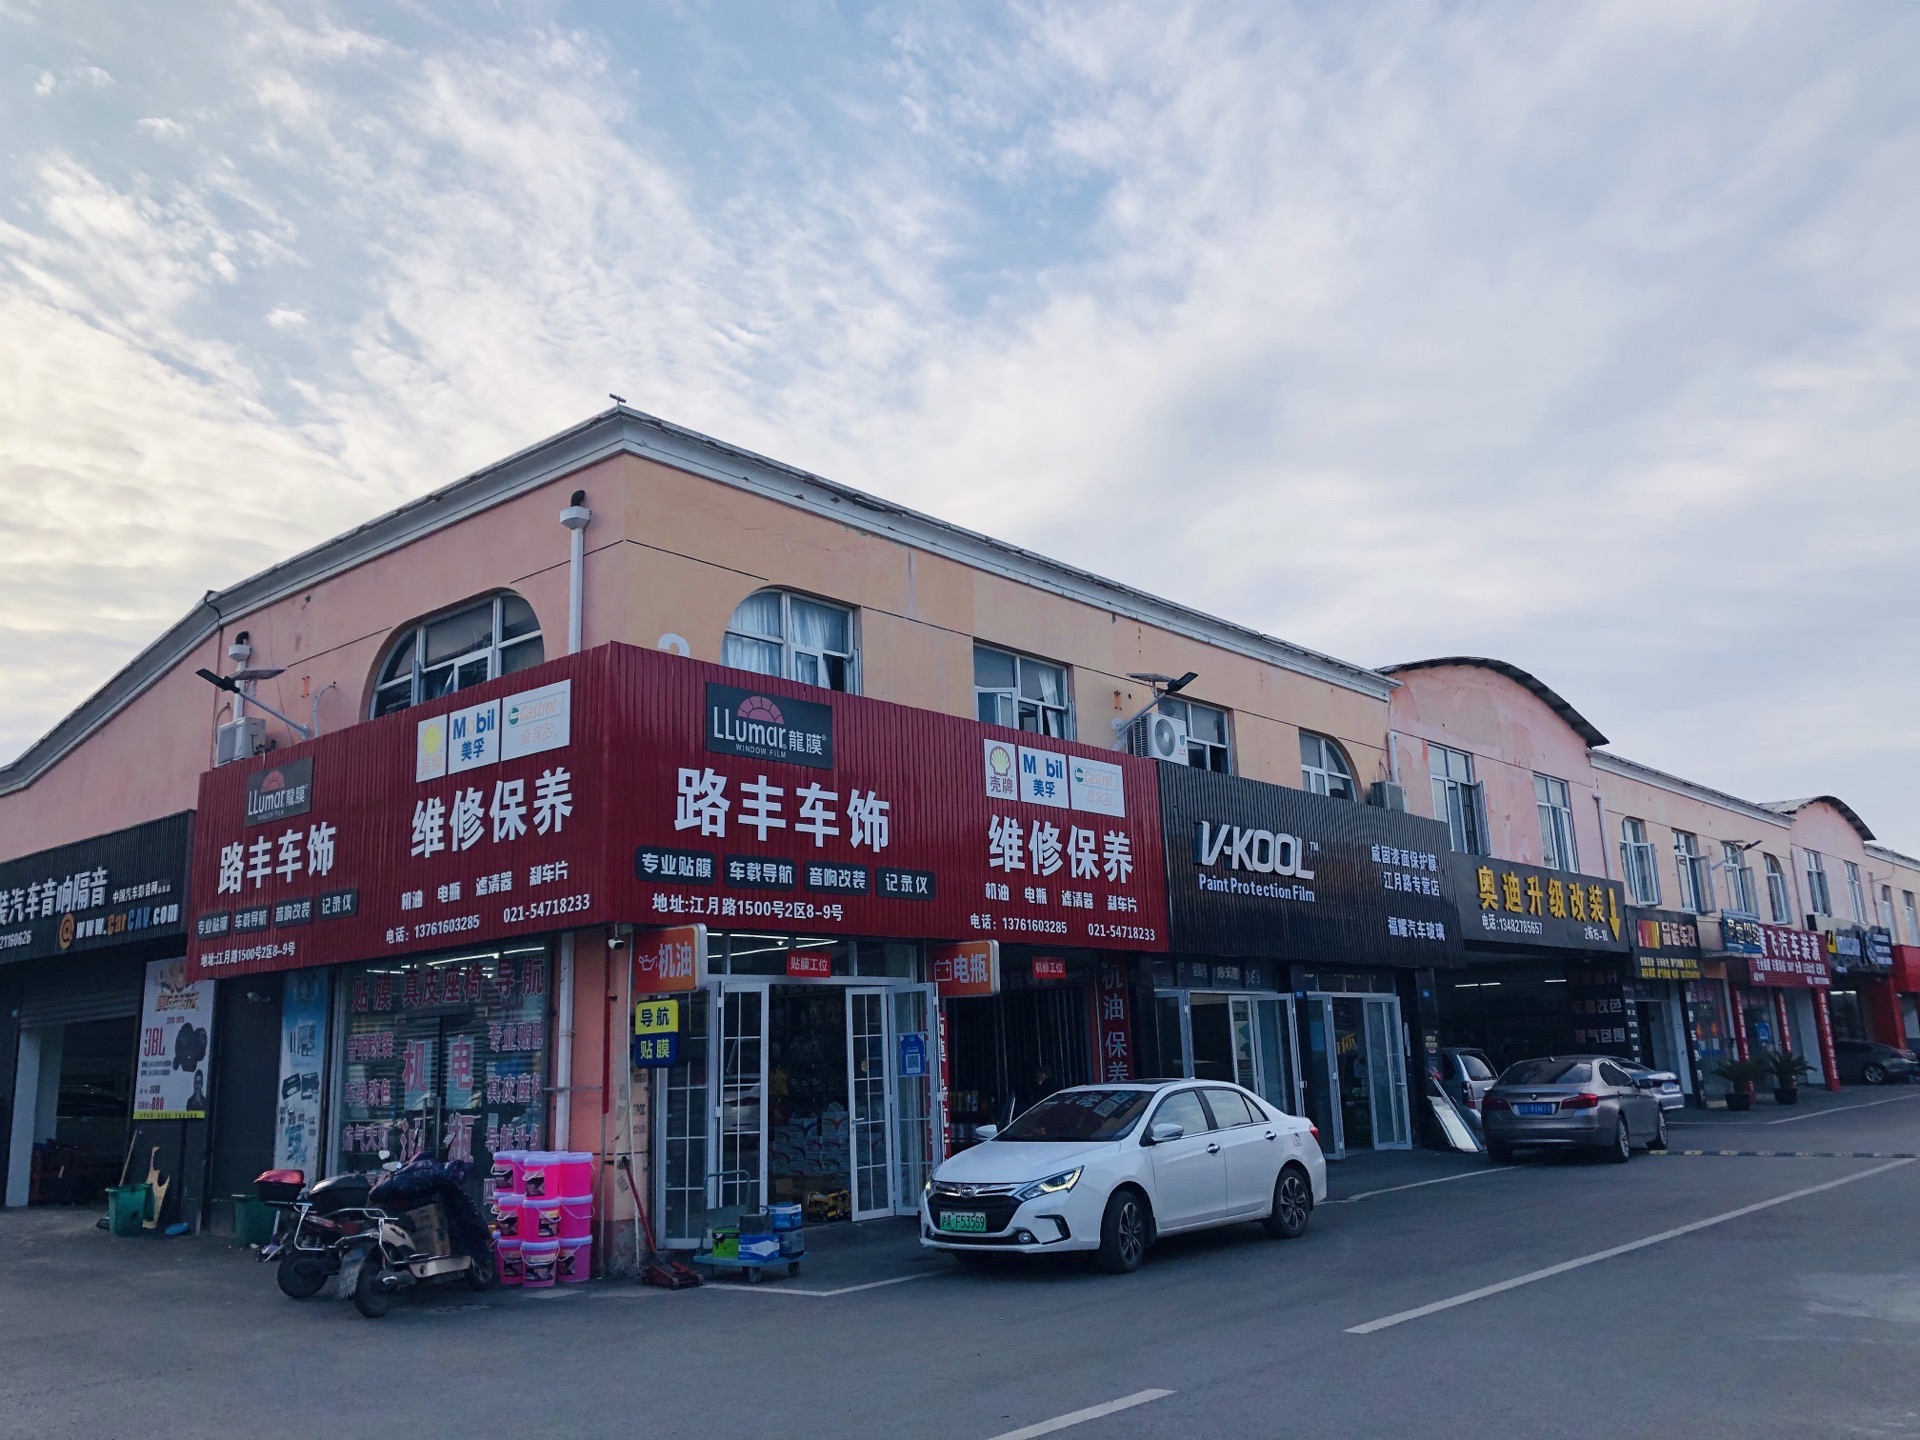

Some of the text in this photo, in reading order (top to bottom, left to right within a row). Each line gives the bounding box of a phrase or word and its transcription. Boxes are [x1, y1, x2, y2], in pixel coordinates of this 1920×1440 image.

[452, 708, 495, 740] Mobil
[713, 706, 823, 755] LLumar 龍膜
[461, 737, 485, 762] 美孚
[735, 743, 787, 758] WINDOW FILM
[1023, 753, 1063, 780] Mobil
[990, 776, 1014, 795] 壳牌
[1033, 779, 1056, 798] 美孚
[248, 789, 286, 816] LLumar
[410, 766, 573, 859] 维修保养
[674, 767, 890, 853] 路丰车饰
[217, 821, 337, 895] 路丰车饰
[988, 813, 1134, 884] 维修保养
[1200, 820, 1315, 880] V-KOOL
[1371, 843, 1437, 872] 威固漆面保护膜
[401, 861, 568, 911] 机油 电瓶 滤清器 刹车片
[641, 852, 929, 894] 专业贴膜 车载导航 音响改装 记录仪
[1383, 871, 1440, 896] 江月路专营店
[985, 882, 1137, 913] 机油 电瓶 滤清器 刹车片
[1199, 874, 1315, 902] Paint Protection Film
[1477, 865, 1606, 923] 奥迪升级改装
[198, 894, 353, 936] 专业贴膜 车载导航 音响改装 记录仪
[503, 893, 591, 924] 021-54718233
[652, 893, 843, 921] 地址:江月路1500号2区8-9号
[1088, 923, 1155, 941] 021-54718233
[1388, 915, 1445, 941] 福耀汽车玻璃
[200, 942, 296, 968] 地址:江月路1500号2区8-9号
[659, 942, 693, 979] 机油
[790, 957, 828, 972] 贴膜工位
[953, 953, 988, 983] 电瓶
[1035, 961, 1064, 974] 机修工位
[403, 961, 483, 1006] 真皮座椅
[640, 1007, 670, 1027] 导航
[144, 1027, 166, 1056] JBL
[348, 1031, 393, 1061] 音响改装
[640, 1039, 670, 1060] 贴膜
